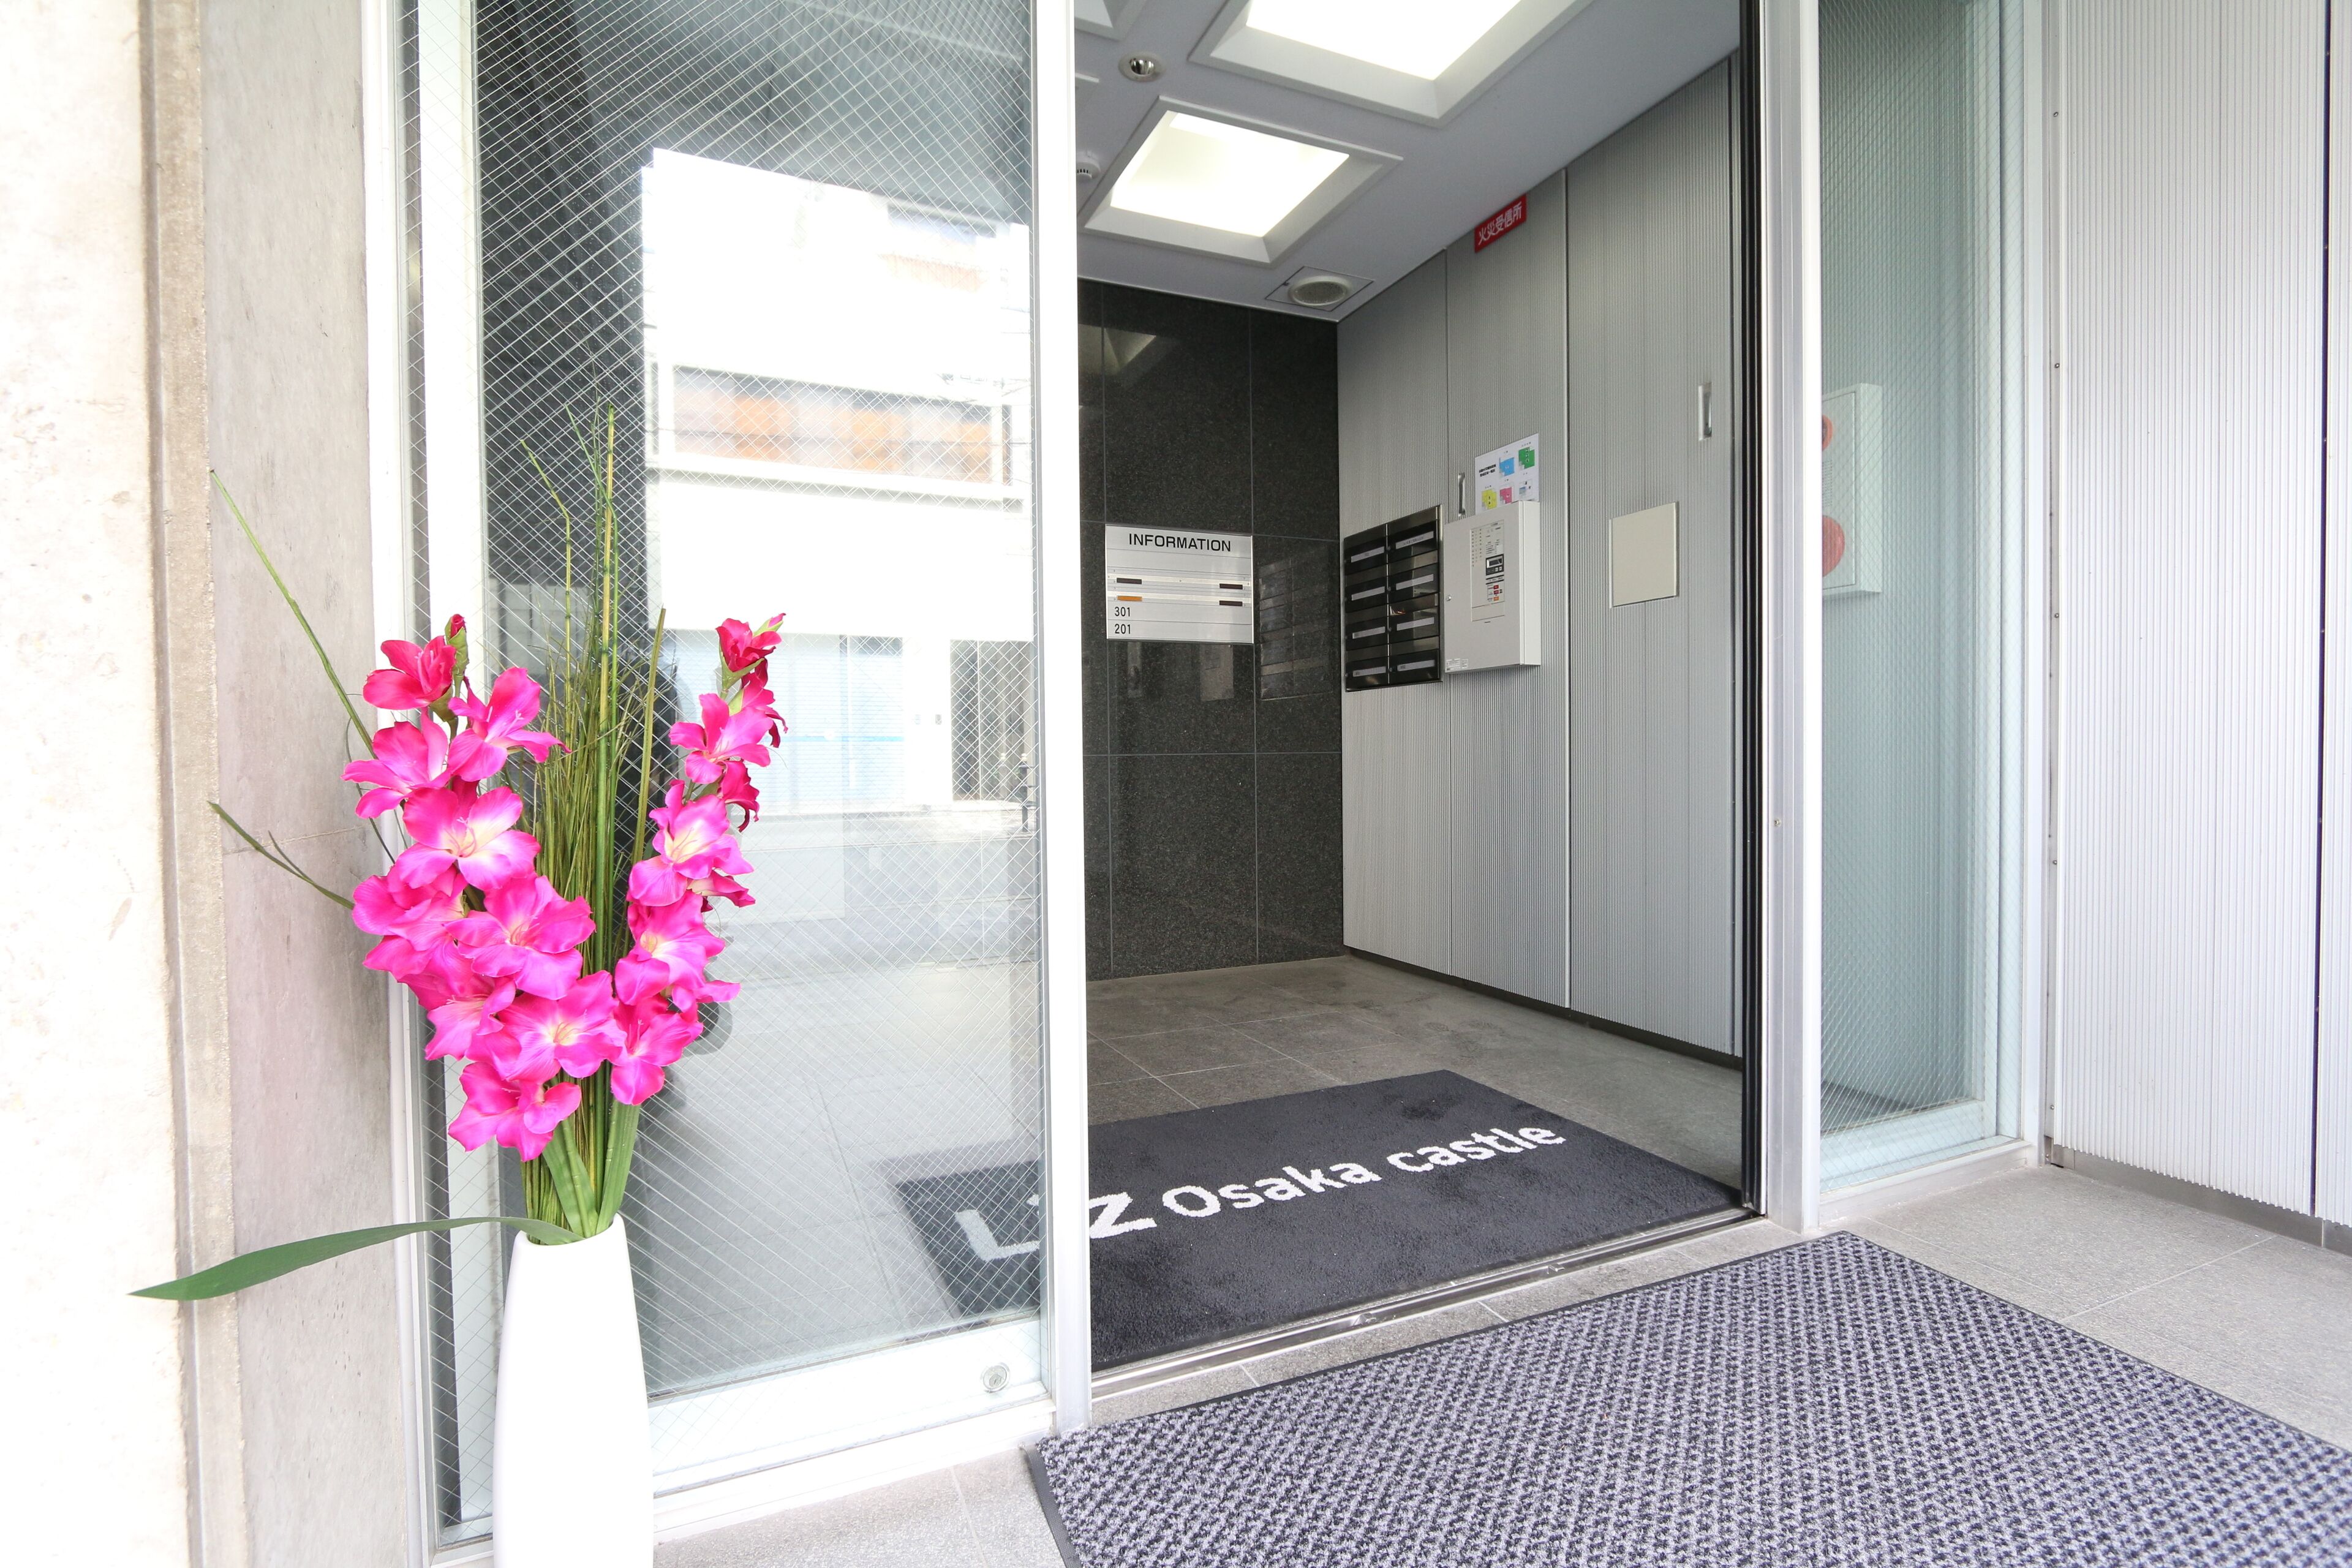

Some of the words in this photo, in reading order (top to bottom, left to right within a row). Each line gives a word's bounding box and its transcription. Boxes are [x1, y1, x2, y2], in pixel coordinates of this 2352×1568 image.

[1478, 201, 1522, 246] 火災受信所
[1129, 533, 1231, 552] INFORMATION
[1114, 606, 1131, 617] 301
[1114, 624, 1131, 635] 201
[1163, 1163, 1382, 1218] Osaka
[1386, 1127, 1567, 1173] castle
